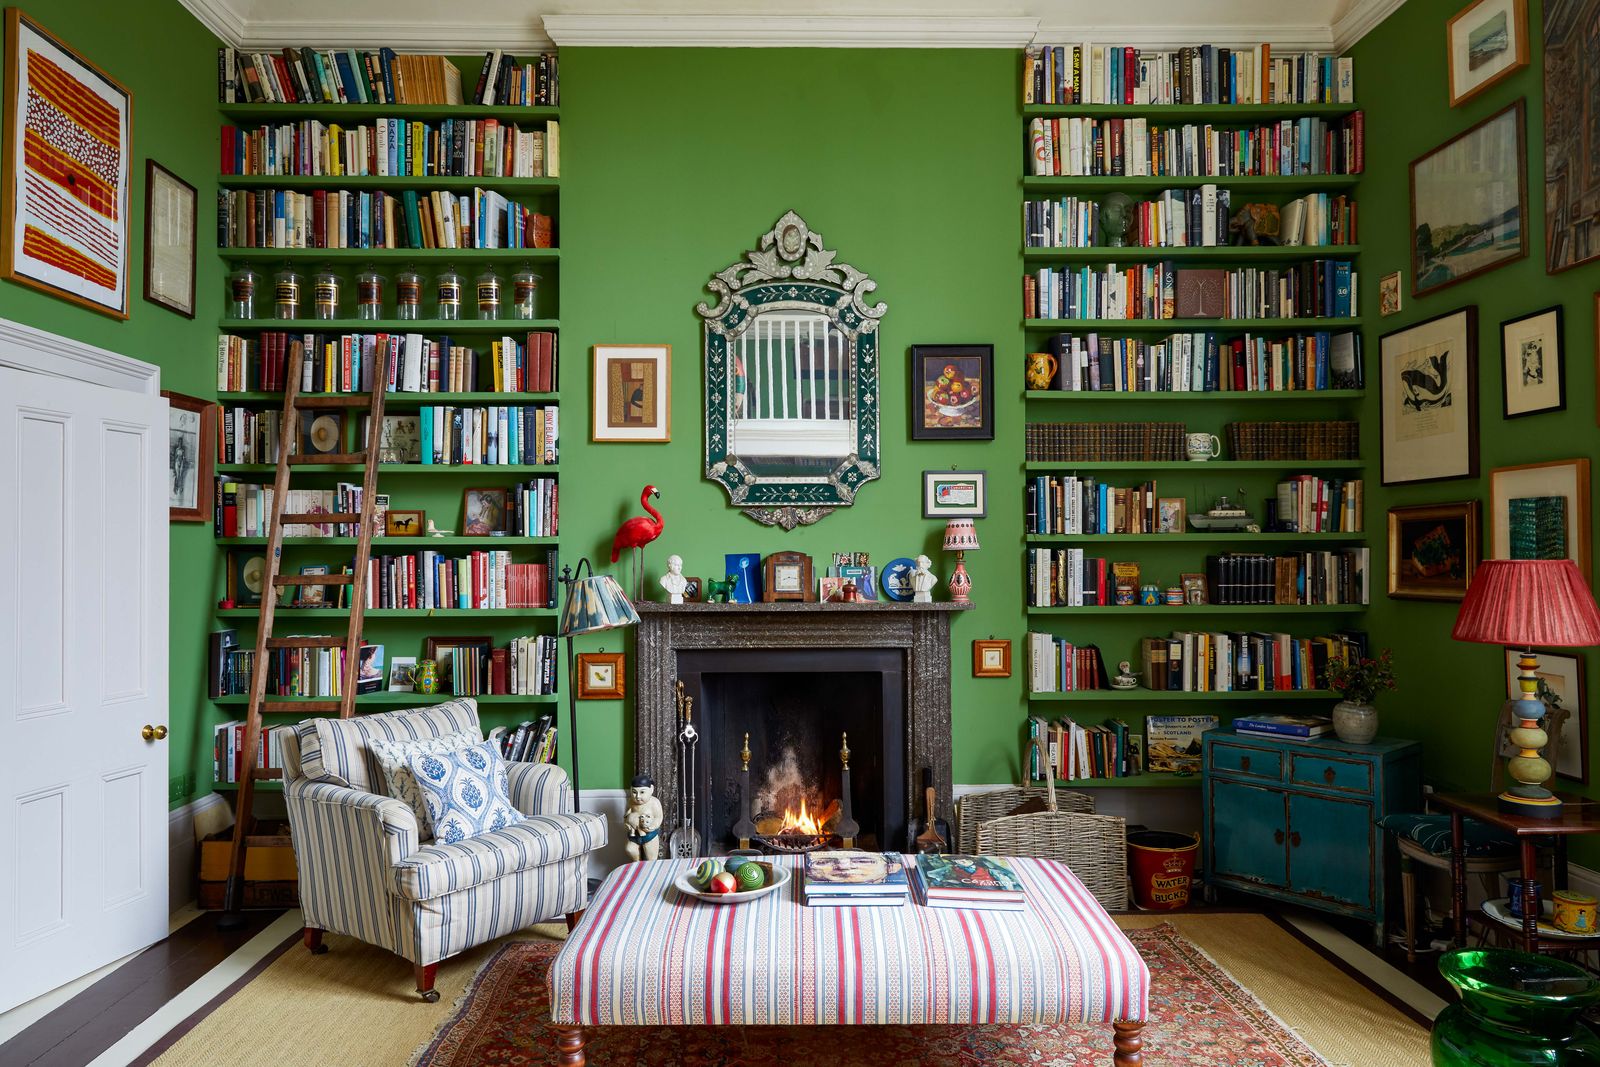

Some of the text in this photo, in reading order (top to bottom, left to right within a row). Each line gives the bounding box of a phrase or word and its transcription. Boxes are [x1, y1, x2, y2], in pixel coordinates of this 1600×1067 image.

[225, 413, 234, 444] WINTERLAND
[545, 410, 554, 444] TONY BLAIR
[1156, 877, 1187, 888] WATER
